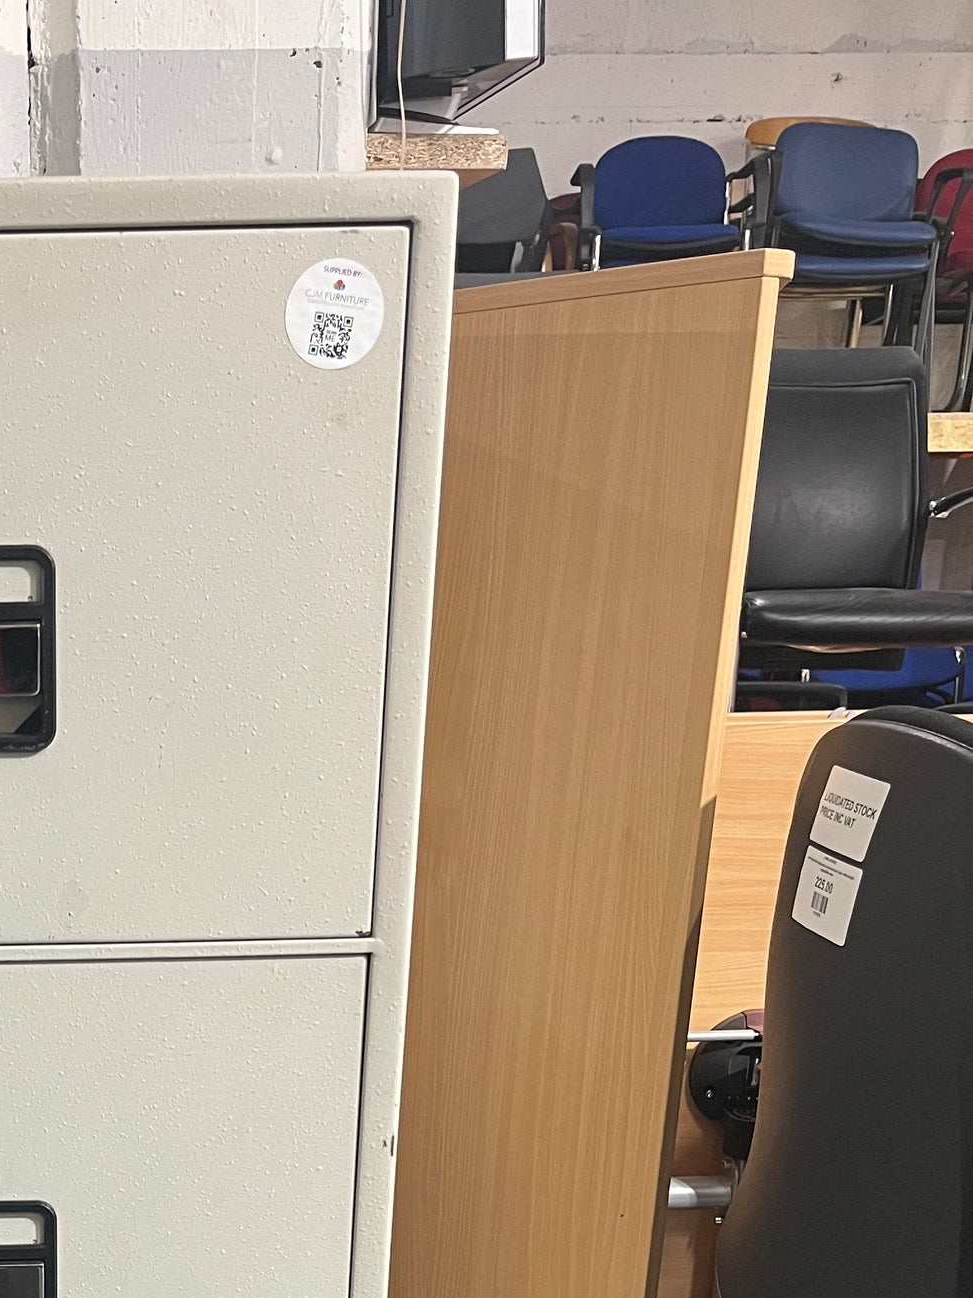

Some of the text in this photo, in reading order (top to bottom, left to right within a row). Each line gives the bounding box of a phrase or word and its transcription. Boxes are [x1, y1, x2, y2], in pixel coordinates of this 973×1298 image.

[323, 265, 353, 276] SUPPLIED
[305, 288, 324, 299] CJM
[324, 291, 370, 306] FURNITURE
[325, 334, 335, 342] ME
[823, 791, 878, 820] LIQUIDATED STOCK
[820, 805, 856, 828] PRICE INC VAT
[814, 876, 834, 894] 225.00
